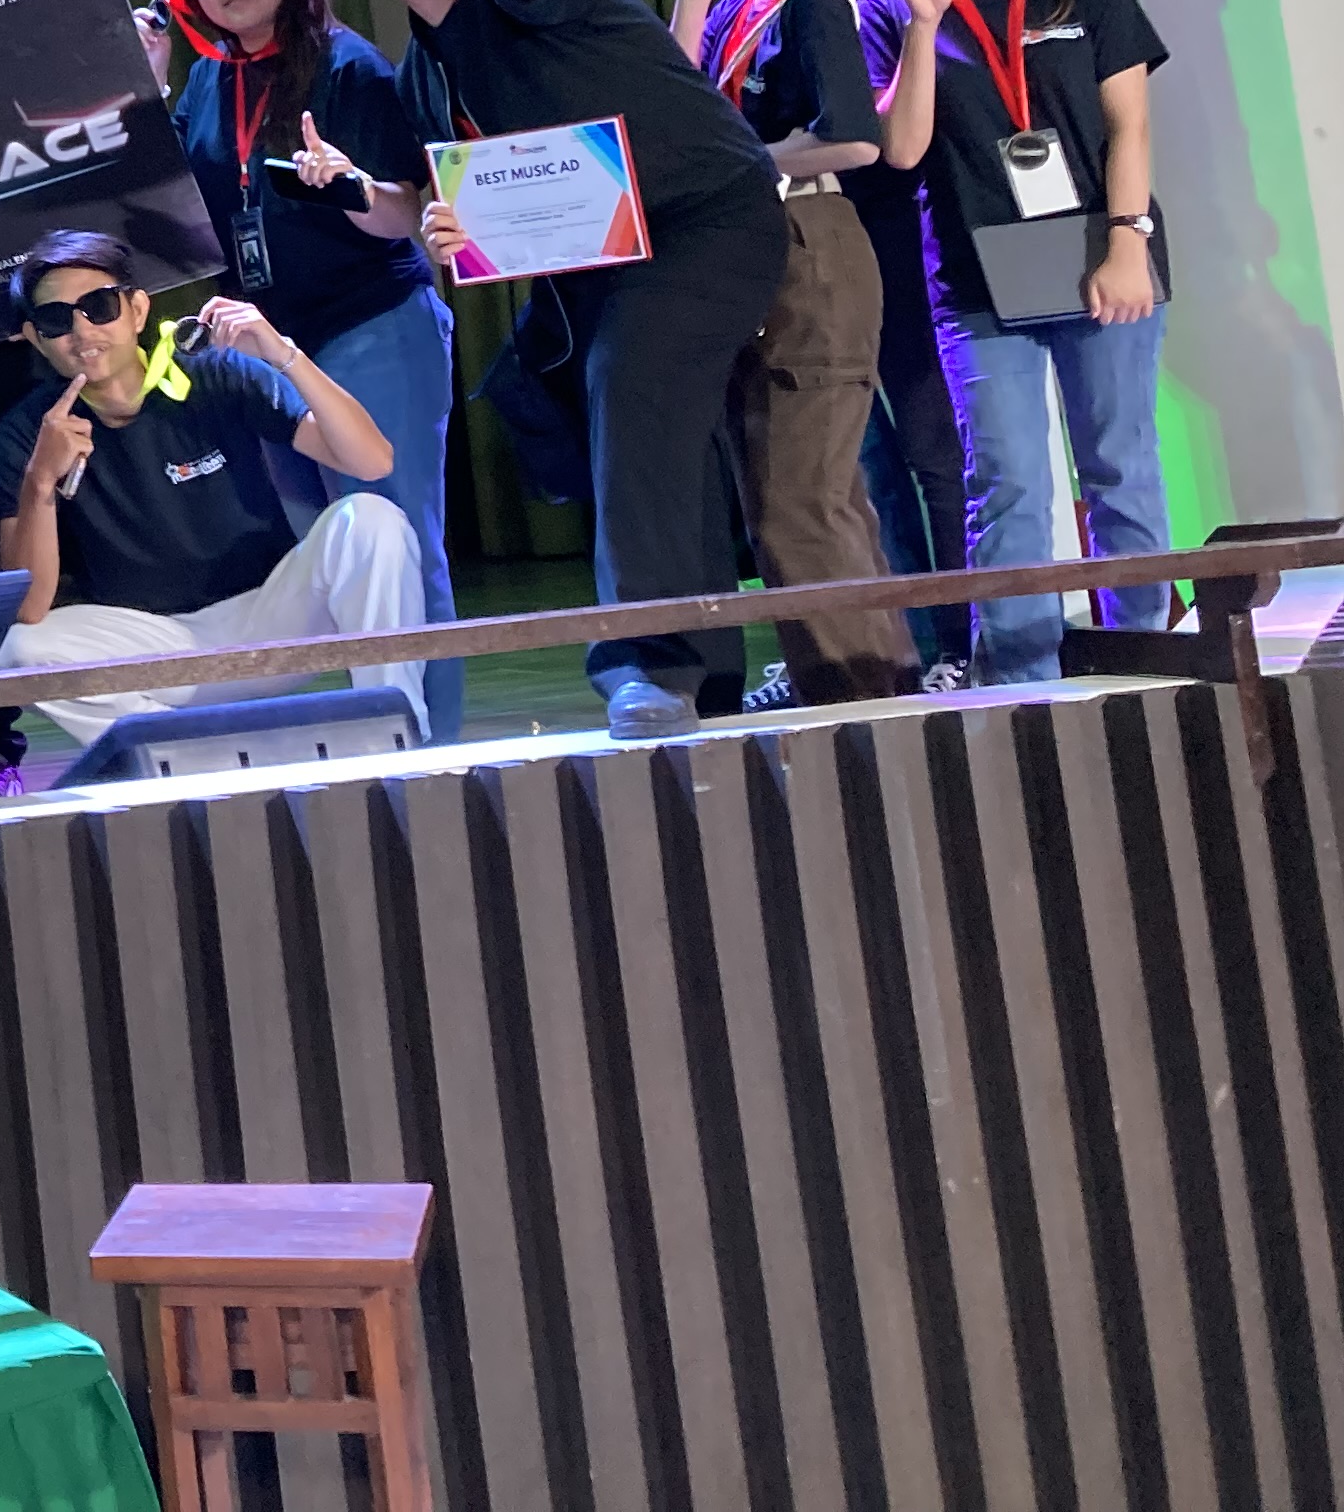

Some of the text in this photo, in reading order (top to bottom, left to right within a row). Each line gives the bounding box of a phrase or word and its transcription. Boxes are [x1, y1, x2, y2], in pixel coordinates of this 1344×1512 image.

[475, 159, 580, 186] BEST MUSIC AD
